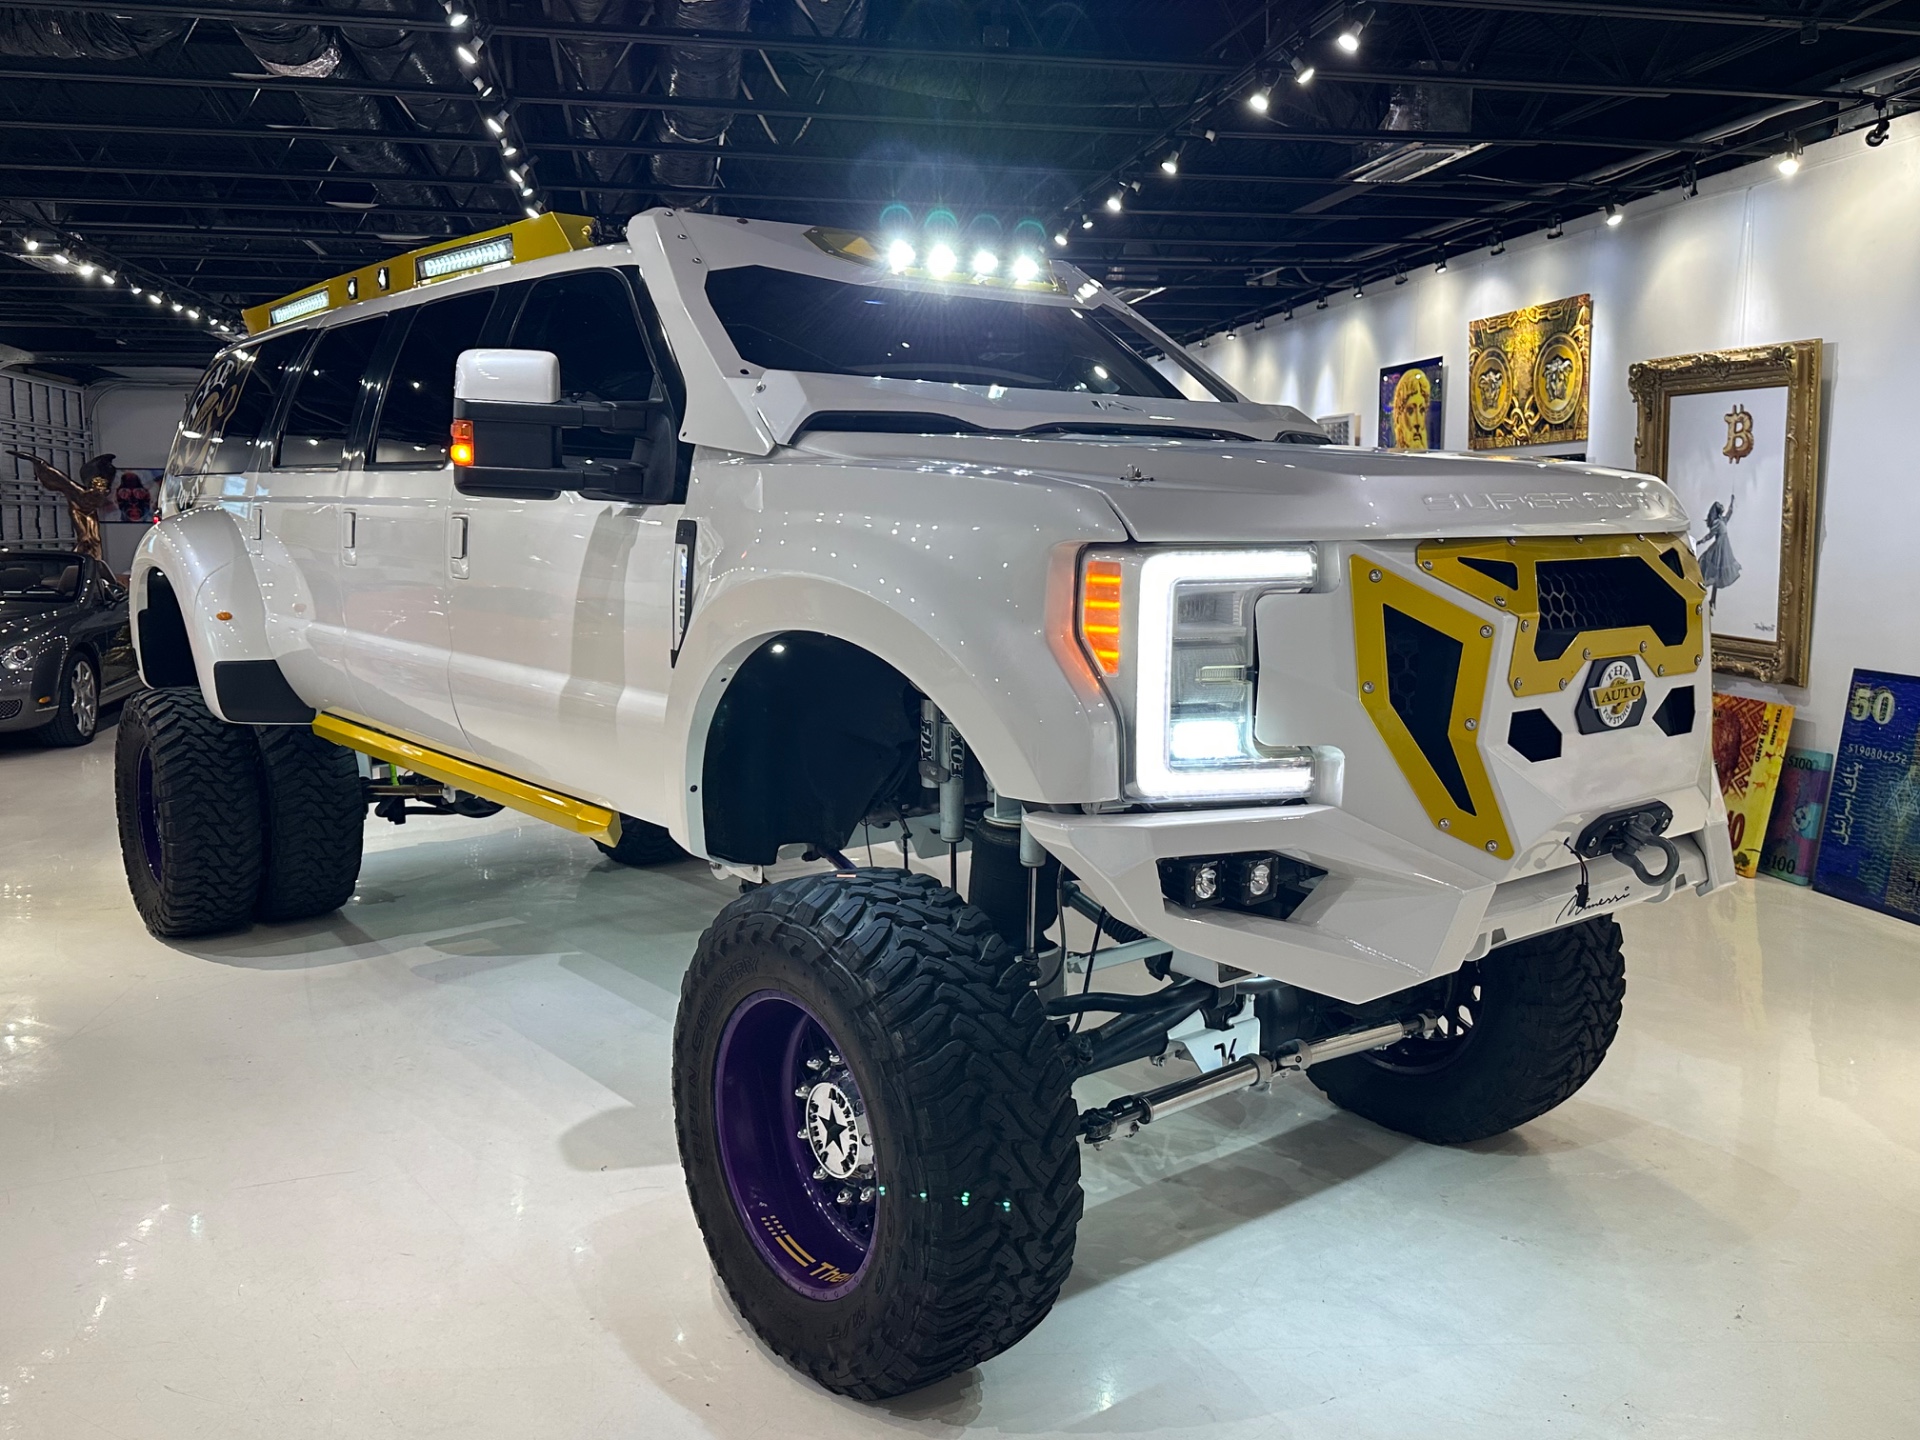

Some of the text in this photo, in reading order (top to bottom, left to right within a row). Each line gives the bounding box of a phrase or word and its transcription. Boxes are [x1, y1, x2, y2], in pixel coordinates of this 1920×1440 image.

[1421, 491, 1666, 512] SUPER DUTY
[1601, 685, 1641, 703] AUTO
[1605, 665, 1631, 682] THE
[1848, 681, 1896, 726] 50
[920, 716, 935, 761] FOX
[948, 727, 966, 779] FOX
[1754, 718, 1770, 763] TEN RAND
[691, 957, 760, 1055] COUNTRY
